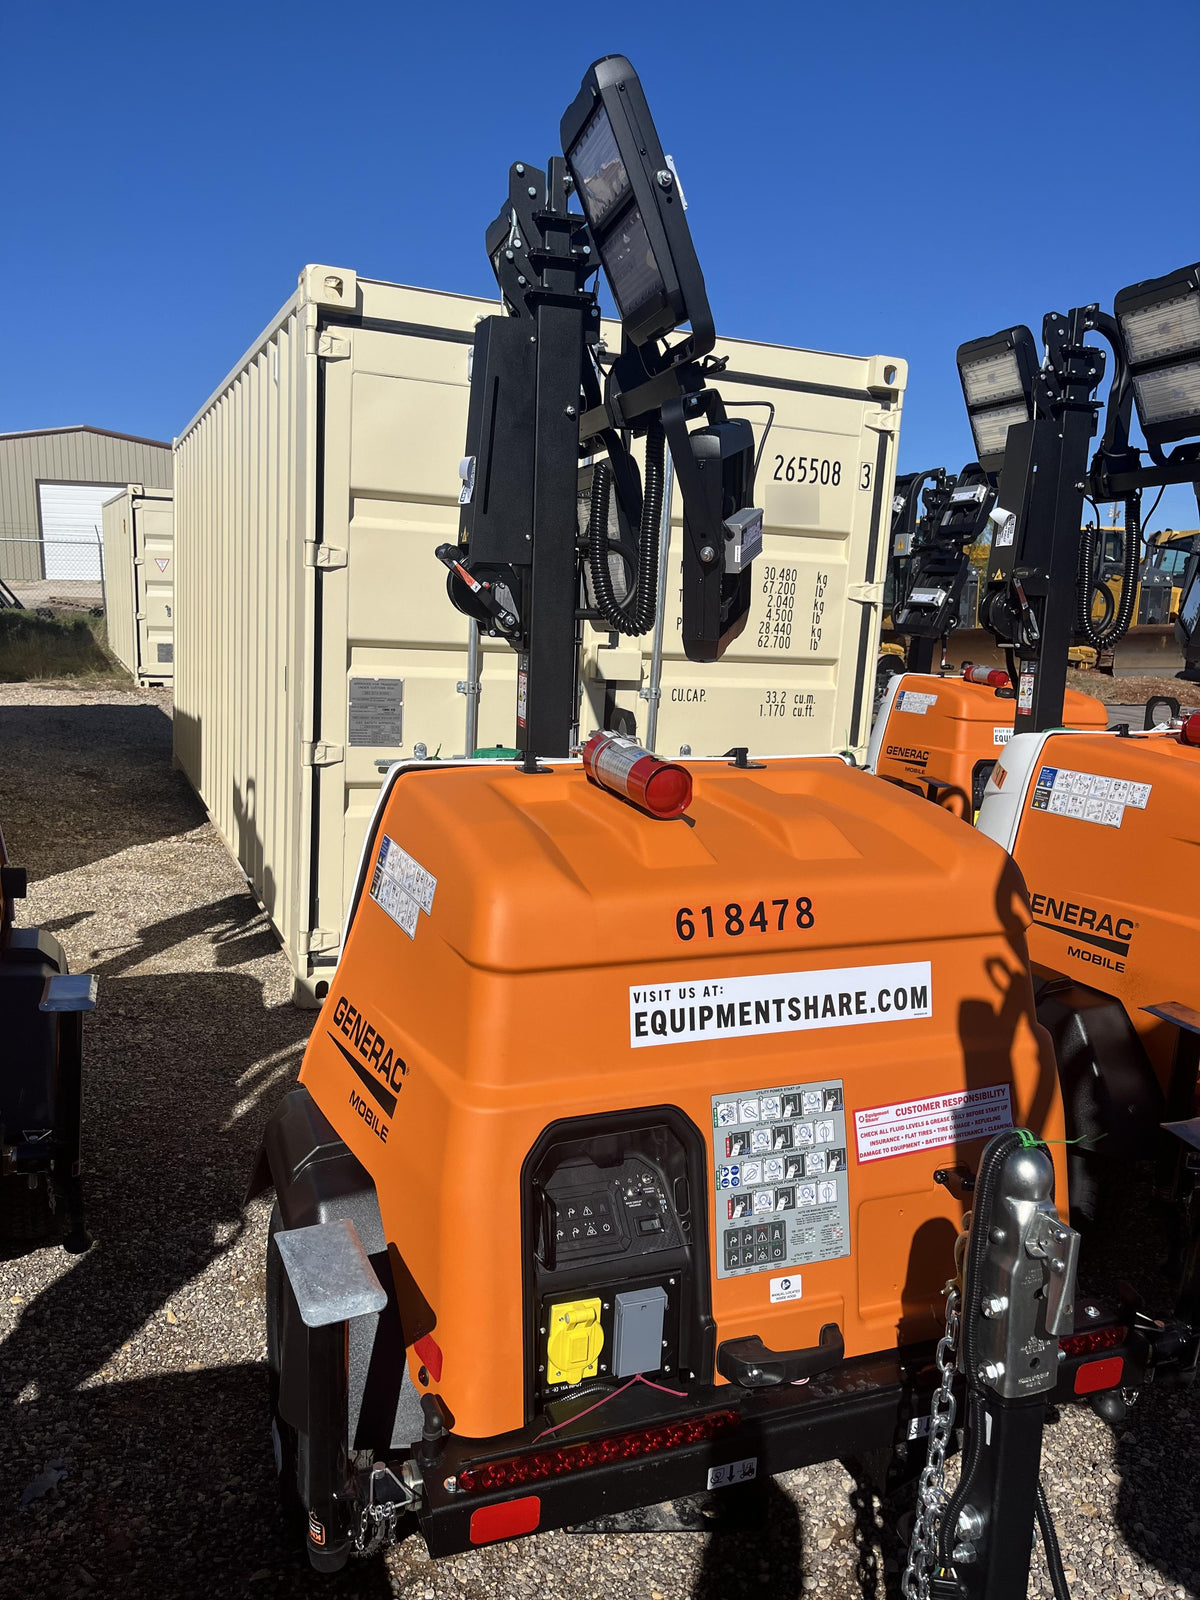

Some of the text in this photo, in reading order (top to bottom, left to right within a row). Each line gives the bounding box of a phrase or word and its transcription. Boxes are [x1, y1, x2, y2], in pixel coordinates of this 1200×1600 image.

[773, 454, 871, 489] 265508 3
[762, 580, 824, 598] 67.200 lb
[763, 566, 828, 588] 30.480 kg
[766, 608, 821, 624] 4.500 lb
[767, 594, 825, 615] 2.040 kg
[757, 635, 818, 651] 62.700 lb
[758, 621, 822, 641] 28.440 kg
[671, 688, 816, 705] CU.CAP. 33.2 cu.m.
[759, 704, 815, 717] 1.170 cu.ft.
[886, 745, 929, 760] GENERAC
[904, 766, 925, 775] MOBILE
[675, 896, 815, 941] 618478
[1028, 891, 1134, 941] ENERAC
[1067, 945, 1126, 973] MOBILE
[633, 985, 723, 1004] VISIT US AT:
[635, 985, 928, 1037] EQUIPMENTSHARE.COM
[333, 996, 407, 1094] GENERAC
[895, 1088, 1006, 1117] CUSTOMER RESPONSIBILITY
[349, 1089, 389, 1144] MOBILE
[860, 1130, 878, 1138] CHECK
[890, 1125, 905, 1133] FLUID
[906, 1121, 924, 1130] LEVELS
[930, 1115, 949, 1125] GREASE
[951, 1113, 965, 1121] DAILY
[966, 1110, 984, 1118] BEFORE
[985, 1106, 1000, 1114] START
[859, 1149, 882, 1158] DAMAGE
[891, 1141, 920, 1152] EQUIPMENT
[925, 1135, 948, 1145] BATTERY
[949, 1128, 984, 1140] MAINTENANCE
[988, 1122, 1012, 1132] CLEANING
[870, 1136, 900, 1146] INSURANCE
[918, 1129, 933, 1137] TIRES
[937, 1125, 948, 1133] TIRE
[950, 1121, 970, 1131] DAMAGE
[975, 1116, 1001, 1126] REFUELING
